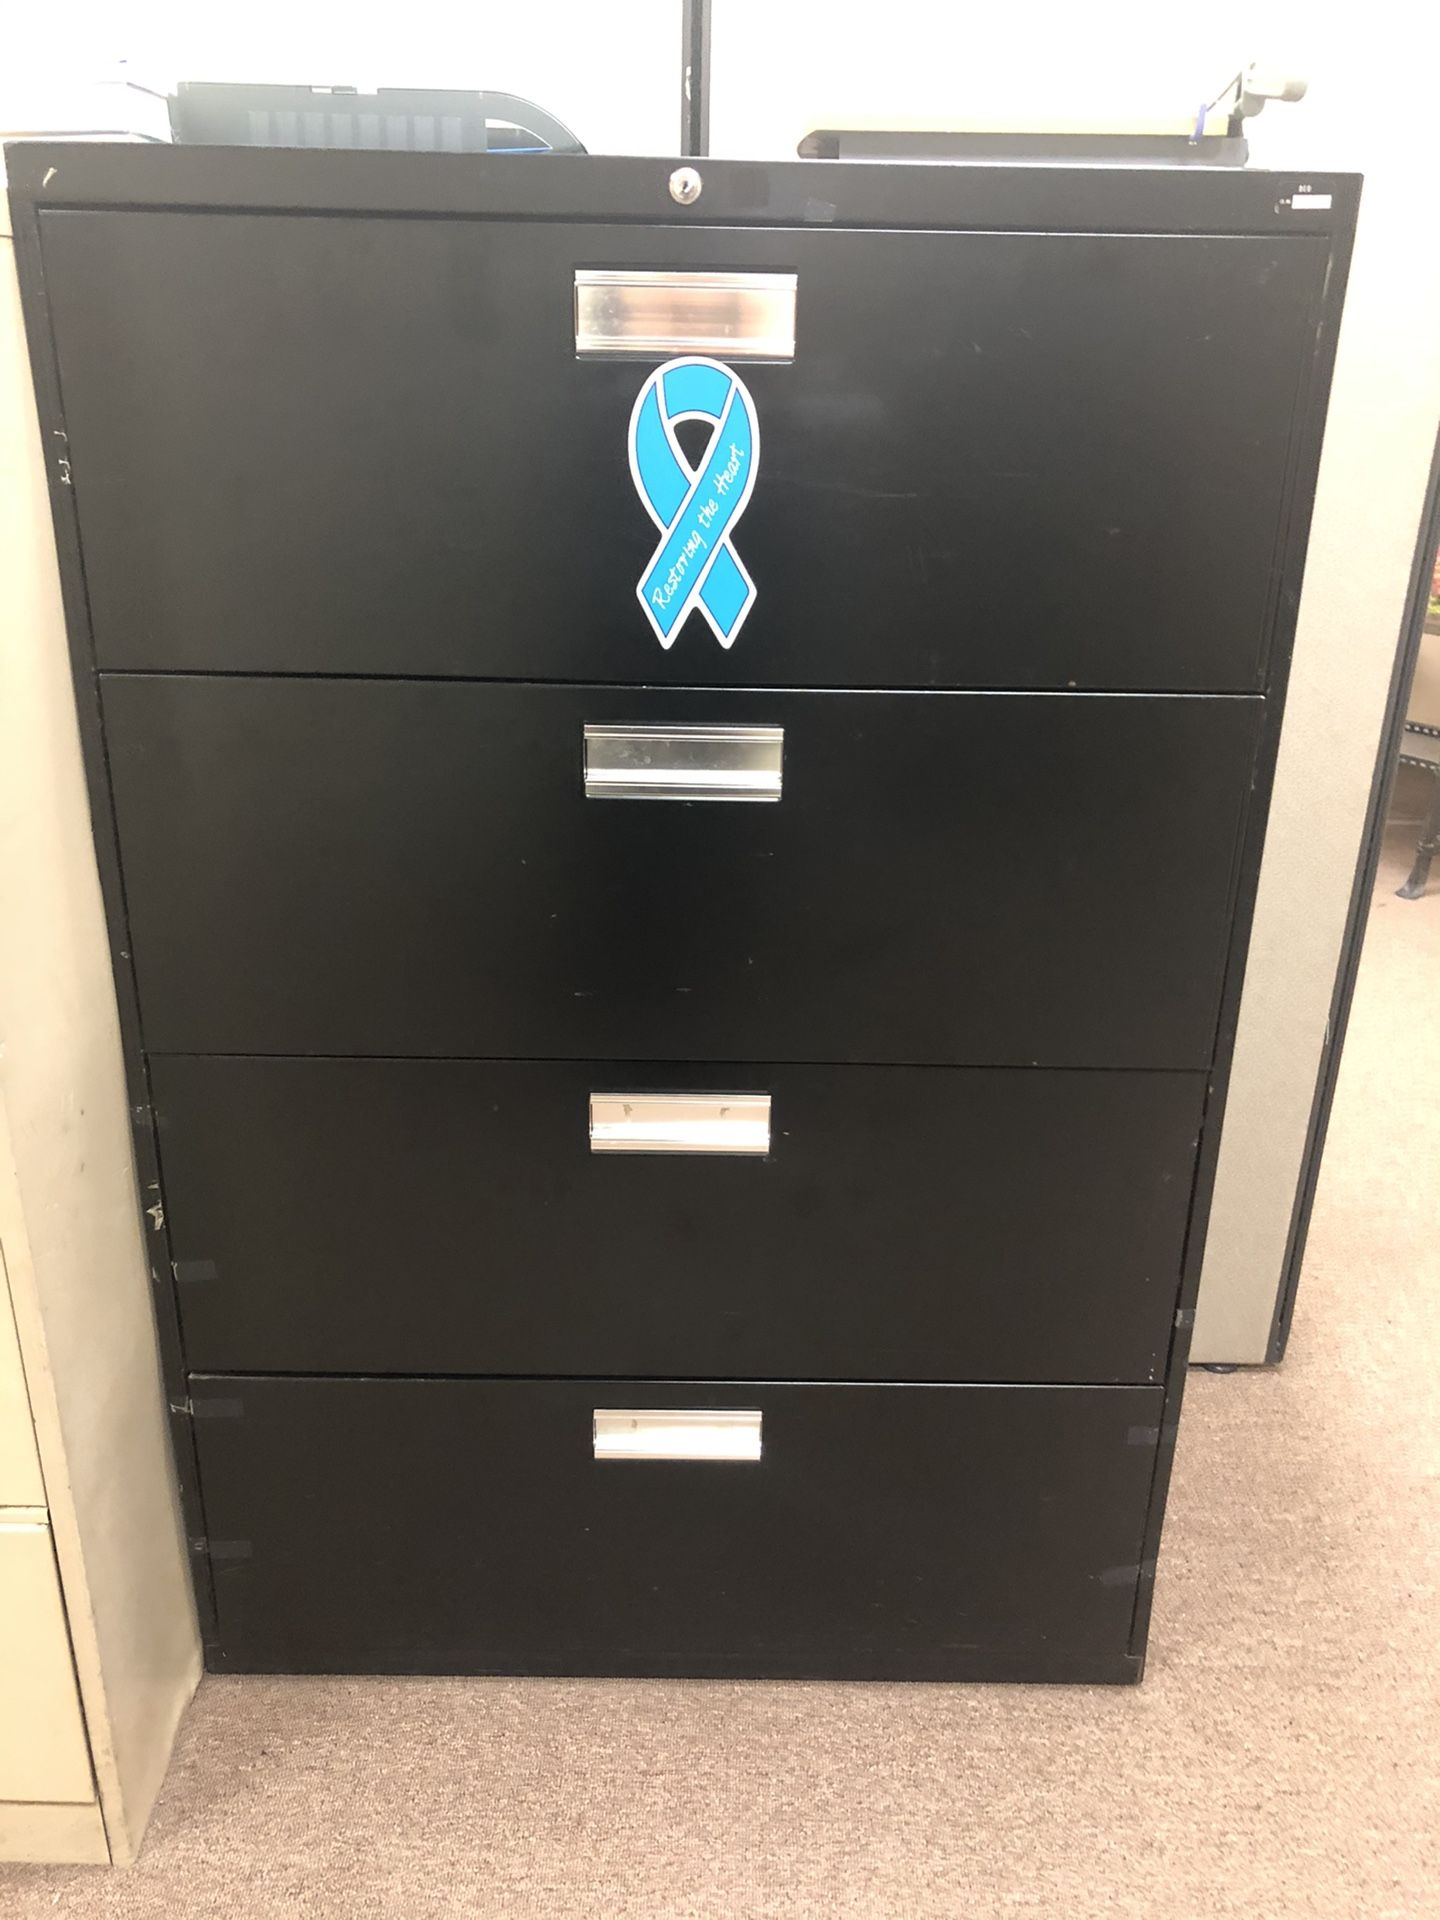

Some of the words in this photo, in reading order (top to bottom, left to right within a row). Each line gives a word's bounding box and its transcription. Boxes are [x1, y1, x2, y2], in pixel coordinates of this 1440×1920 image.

[652, 530, 707, 610] Restoring
[697, 498, 719, 529] the
[713, 442, 745, 496] Heart
